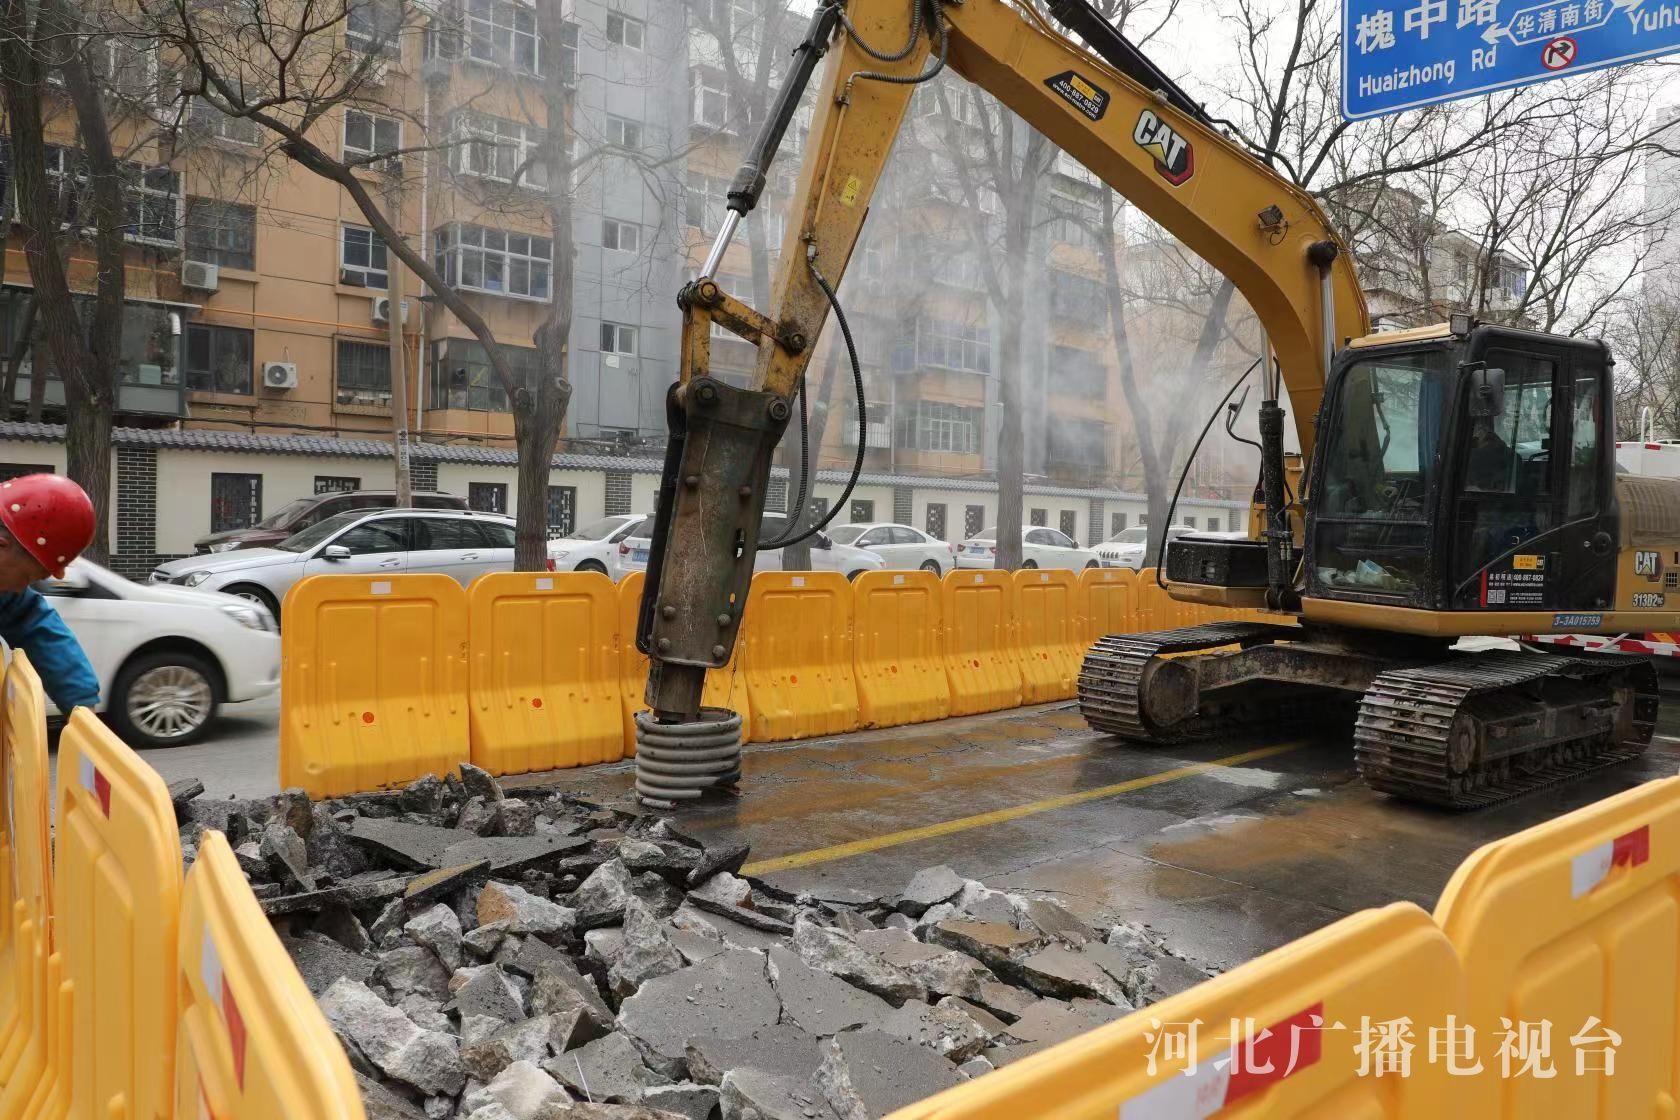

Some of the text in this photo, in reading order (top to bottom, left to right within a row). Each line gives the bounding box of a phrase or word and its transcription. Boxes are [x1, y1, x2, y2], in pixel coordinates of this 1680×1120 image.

[1516, 0, 1603, 38] 华清南街
[1359, 45, 1497, 98] Huaizhong Rd
[1059, 80, 1099, 114] 400-887-0829
[1134, 109, 1188, 170] CAT
[1635, 551, 1658, 575] CAT
